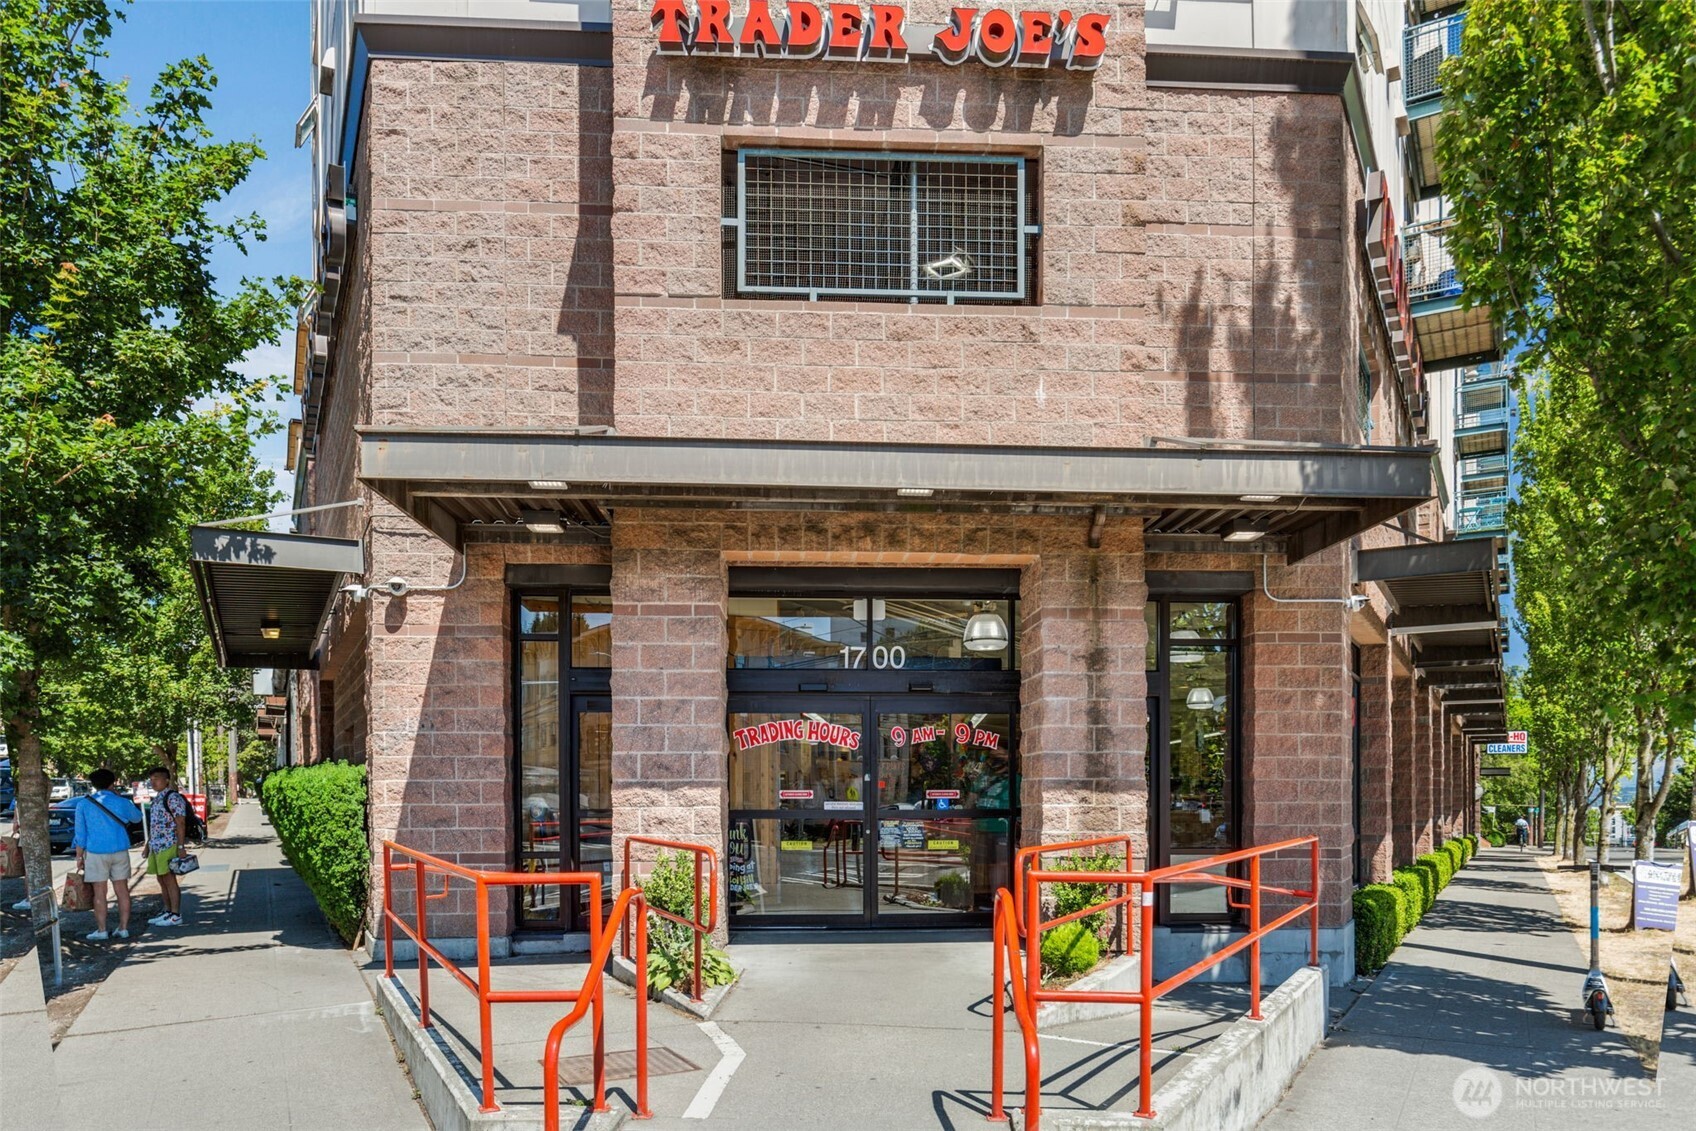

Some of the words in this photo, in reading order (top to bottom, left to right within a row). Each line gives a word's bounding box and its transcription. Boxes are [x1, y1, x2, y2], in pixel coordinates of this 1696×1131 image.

[650, 0, 908, 62] TRADER
[931, 8, 1110, 70] JOE'S
[840, 646, 905, 669] 1700
[733, 719, 804, 750] TRADING
[806, 720, 861, 750] HOURS
[890, 726, 906, 747] 9
[954, 722, 971, 744] 9
[973, 729, 1000, 750] PM
[1507, 732, 1526, 741] -HO
[1488, 744, 1526, 753] CLEANERS
